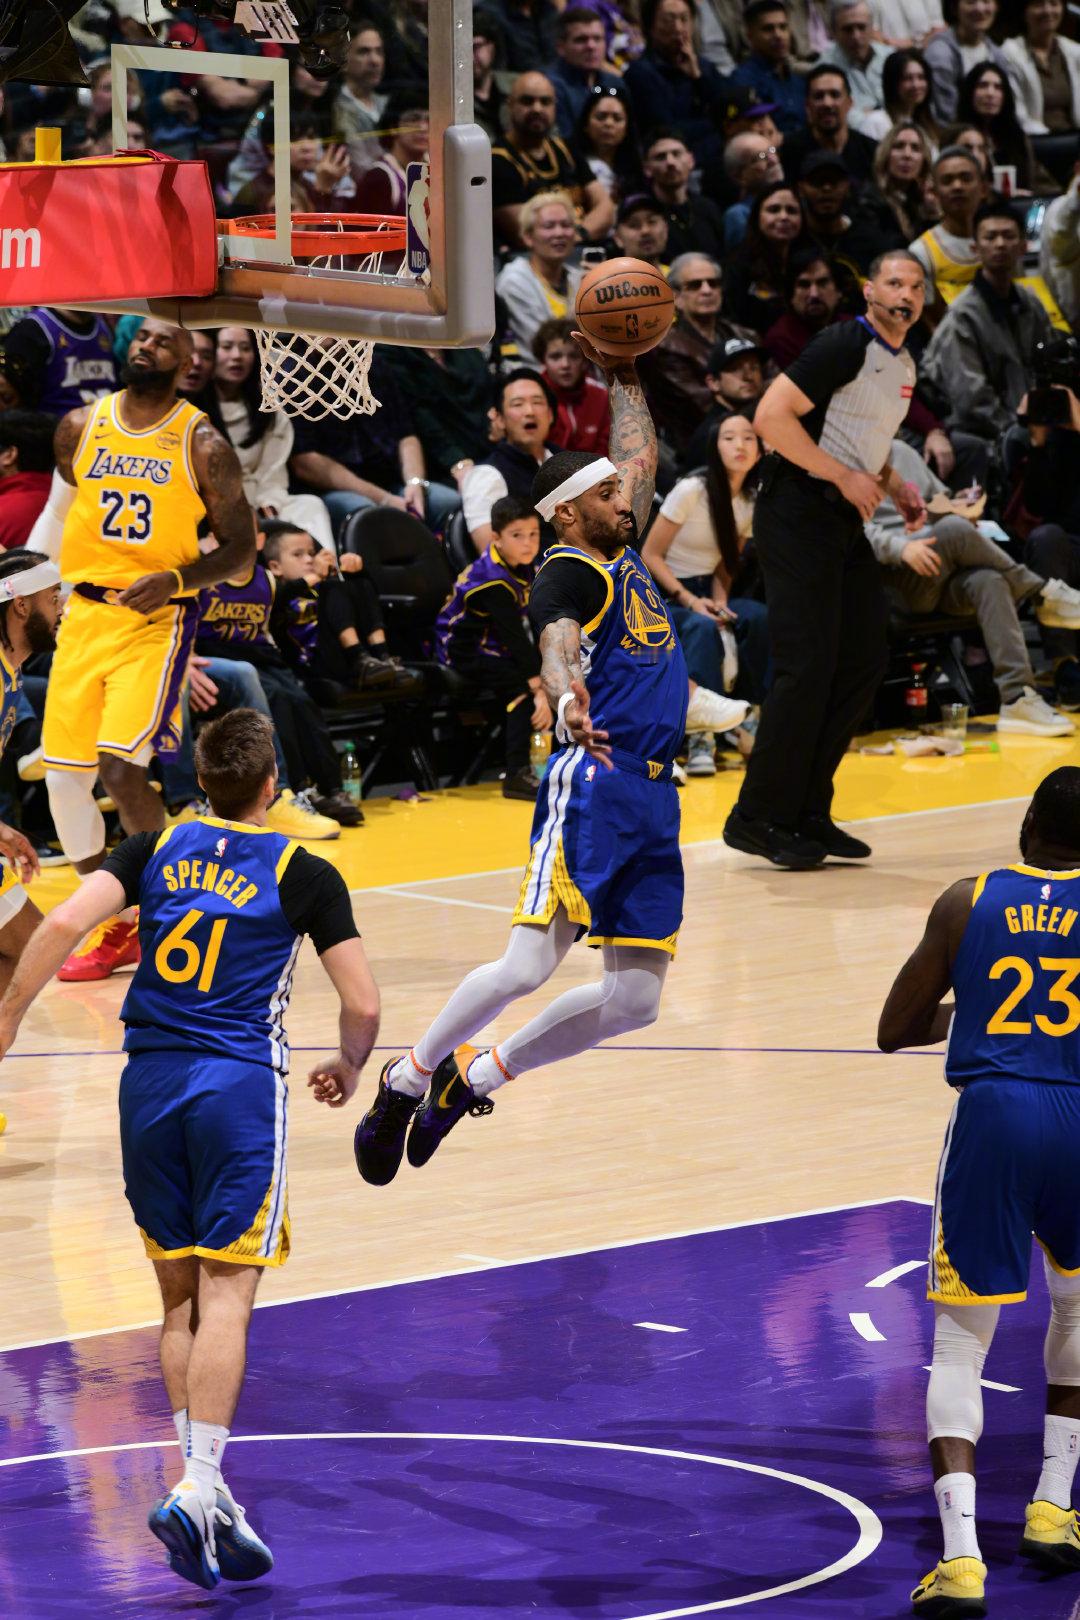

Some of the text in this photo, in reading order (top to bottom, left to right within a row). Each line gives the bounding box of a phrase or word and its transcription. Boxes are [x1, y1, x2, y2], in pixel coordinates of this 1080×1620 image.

[0, 228, 41, 269] m
[411, 250, 427, 269] NBA
[595, 281, 661, 304] Wilson
[84, 448, 172, 484] LAKERS
[99, 489, 152, 543] 23
[202, 597, 266, 624] LAKERS
[162, 859, 259, 909] SPENCER
[1004, 904, 1079, 938] GREEN
[155, 908, 228, 993] 61
[986, 955, 1080, 1037] 23
